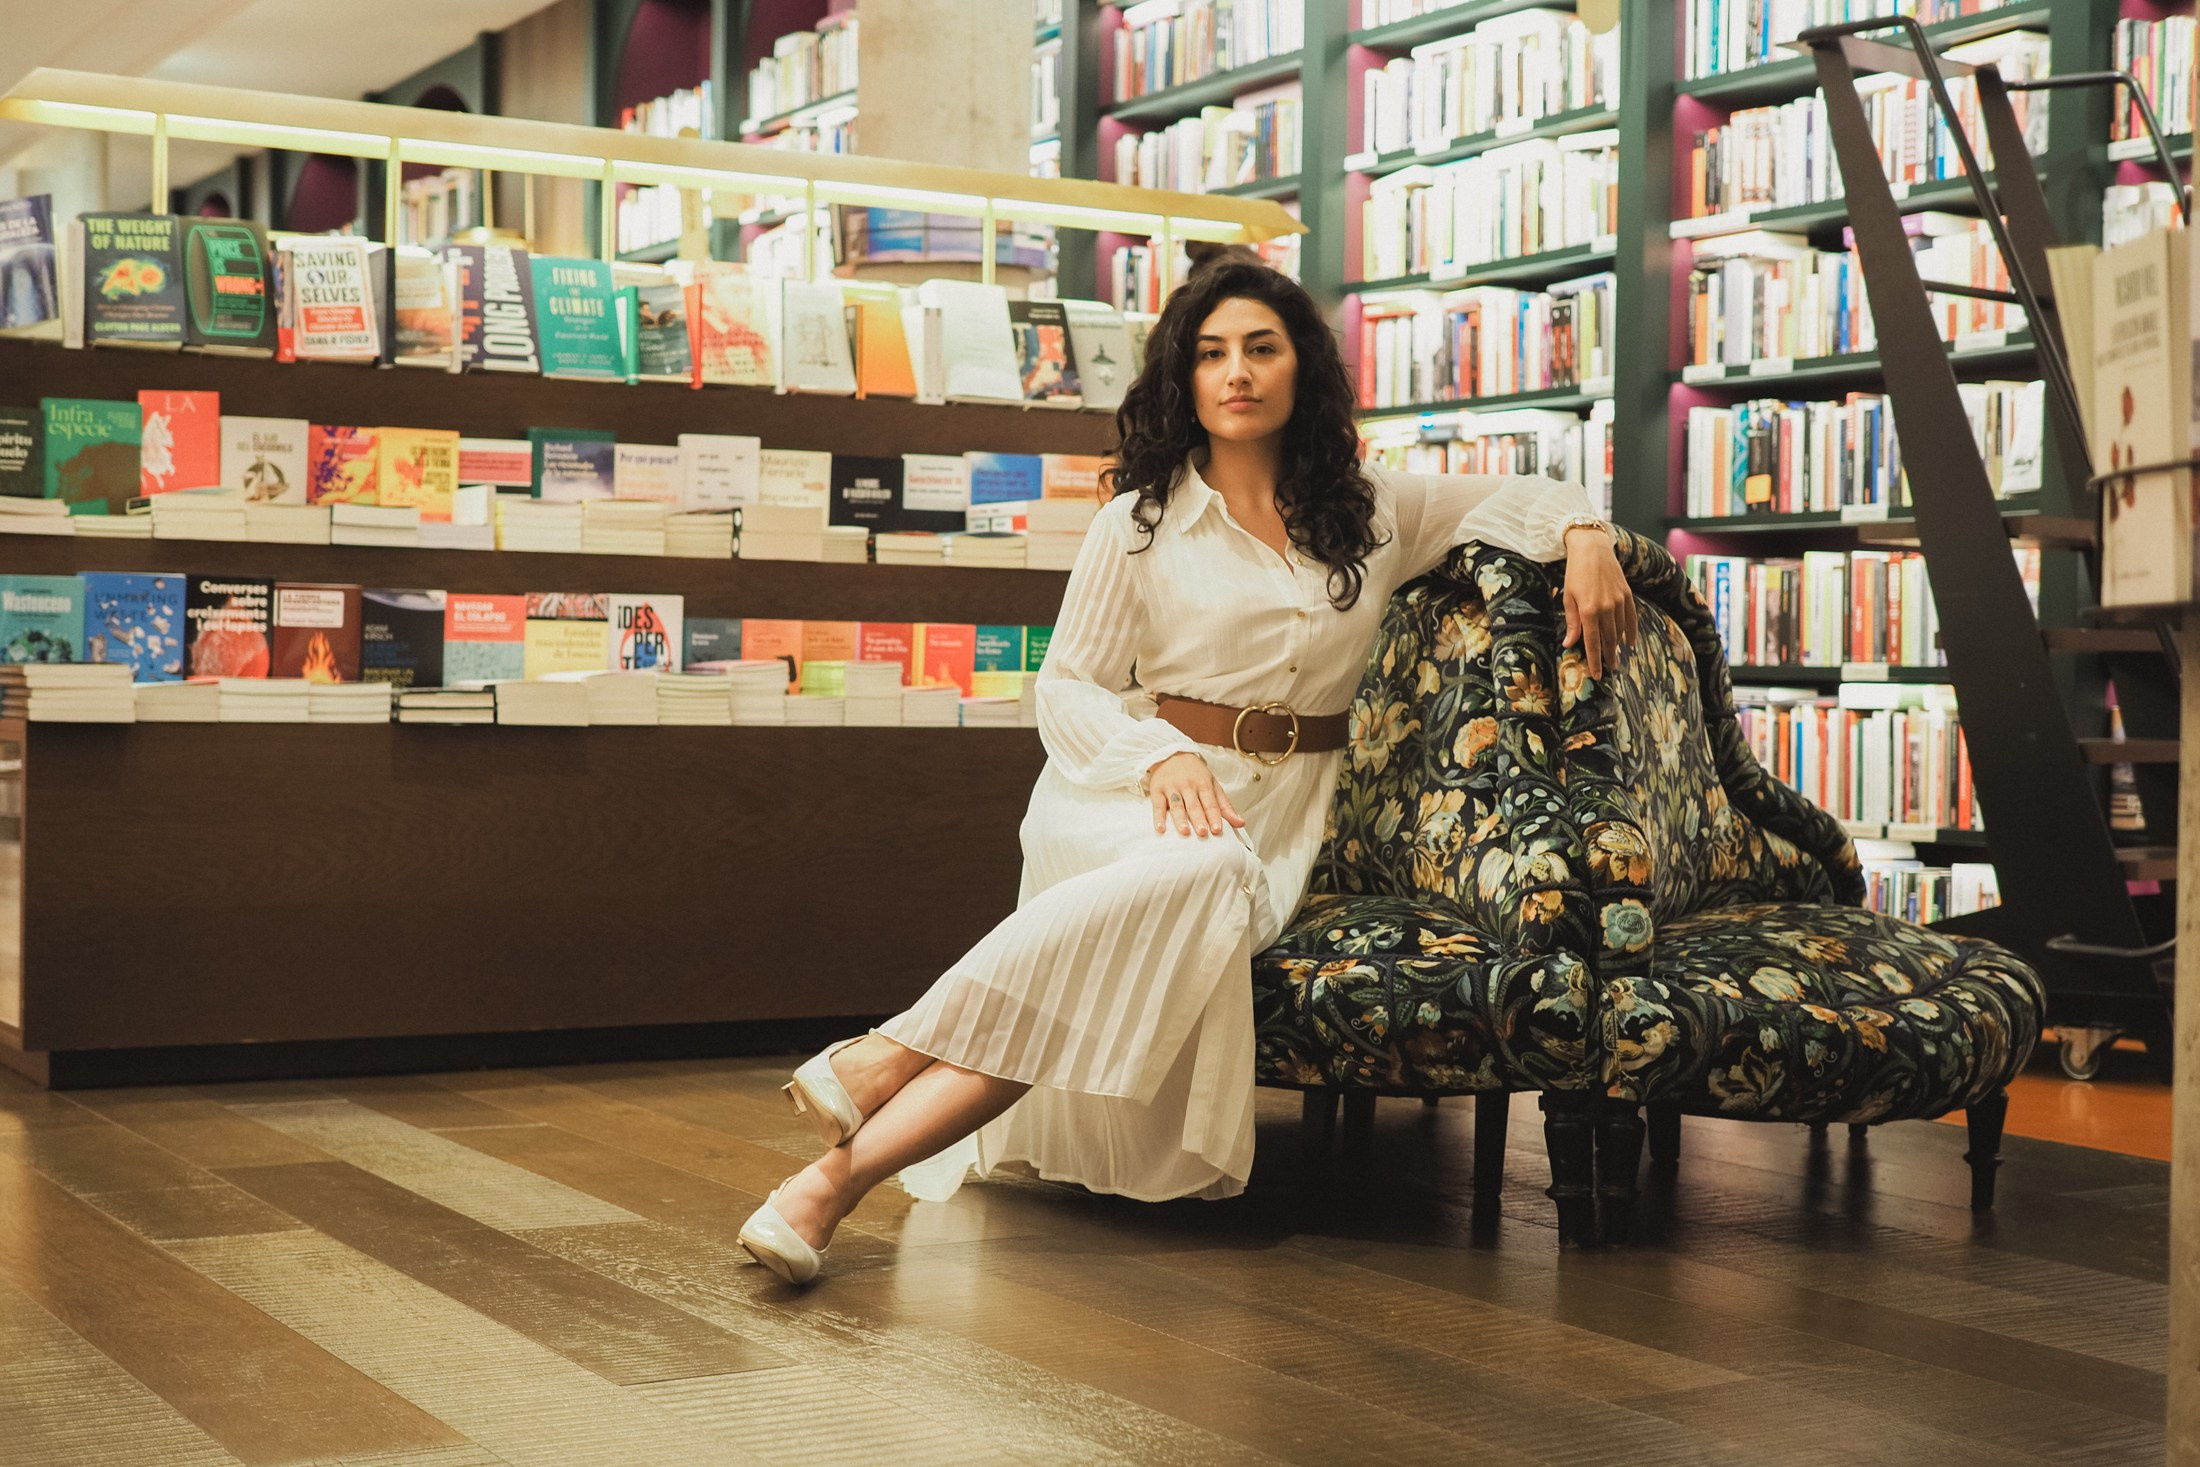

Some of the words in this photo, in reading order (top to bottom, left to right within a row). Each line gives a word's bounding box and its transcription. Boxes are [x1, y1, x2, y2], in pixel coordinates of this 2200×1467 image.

[87, 219, 113, 233] THE
[117, 219, 172, 235] WEIGHT
[92, 235, 110, 249] OF
[115, 235, 170, 251] NATURE
[296, 251, 357, 267] SAVING
[552, 267, 597, 288] FIXING
[302, 287, 360, 303] SELVES
[550, 297, 605, 317] CLIMATE
[483, 302, 540, 372] LONG
[166, 396, 196, 412] LA
[51, 404, 93, 422] Infra
[200, 581, 268, 595] Converses
[231, 596, 268, 608] sobre
[634, 632, 664, 655] PER
